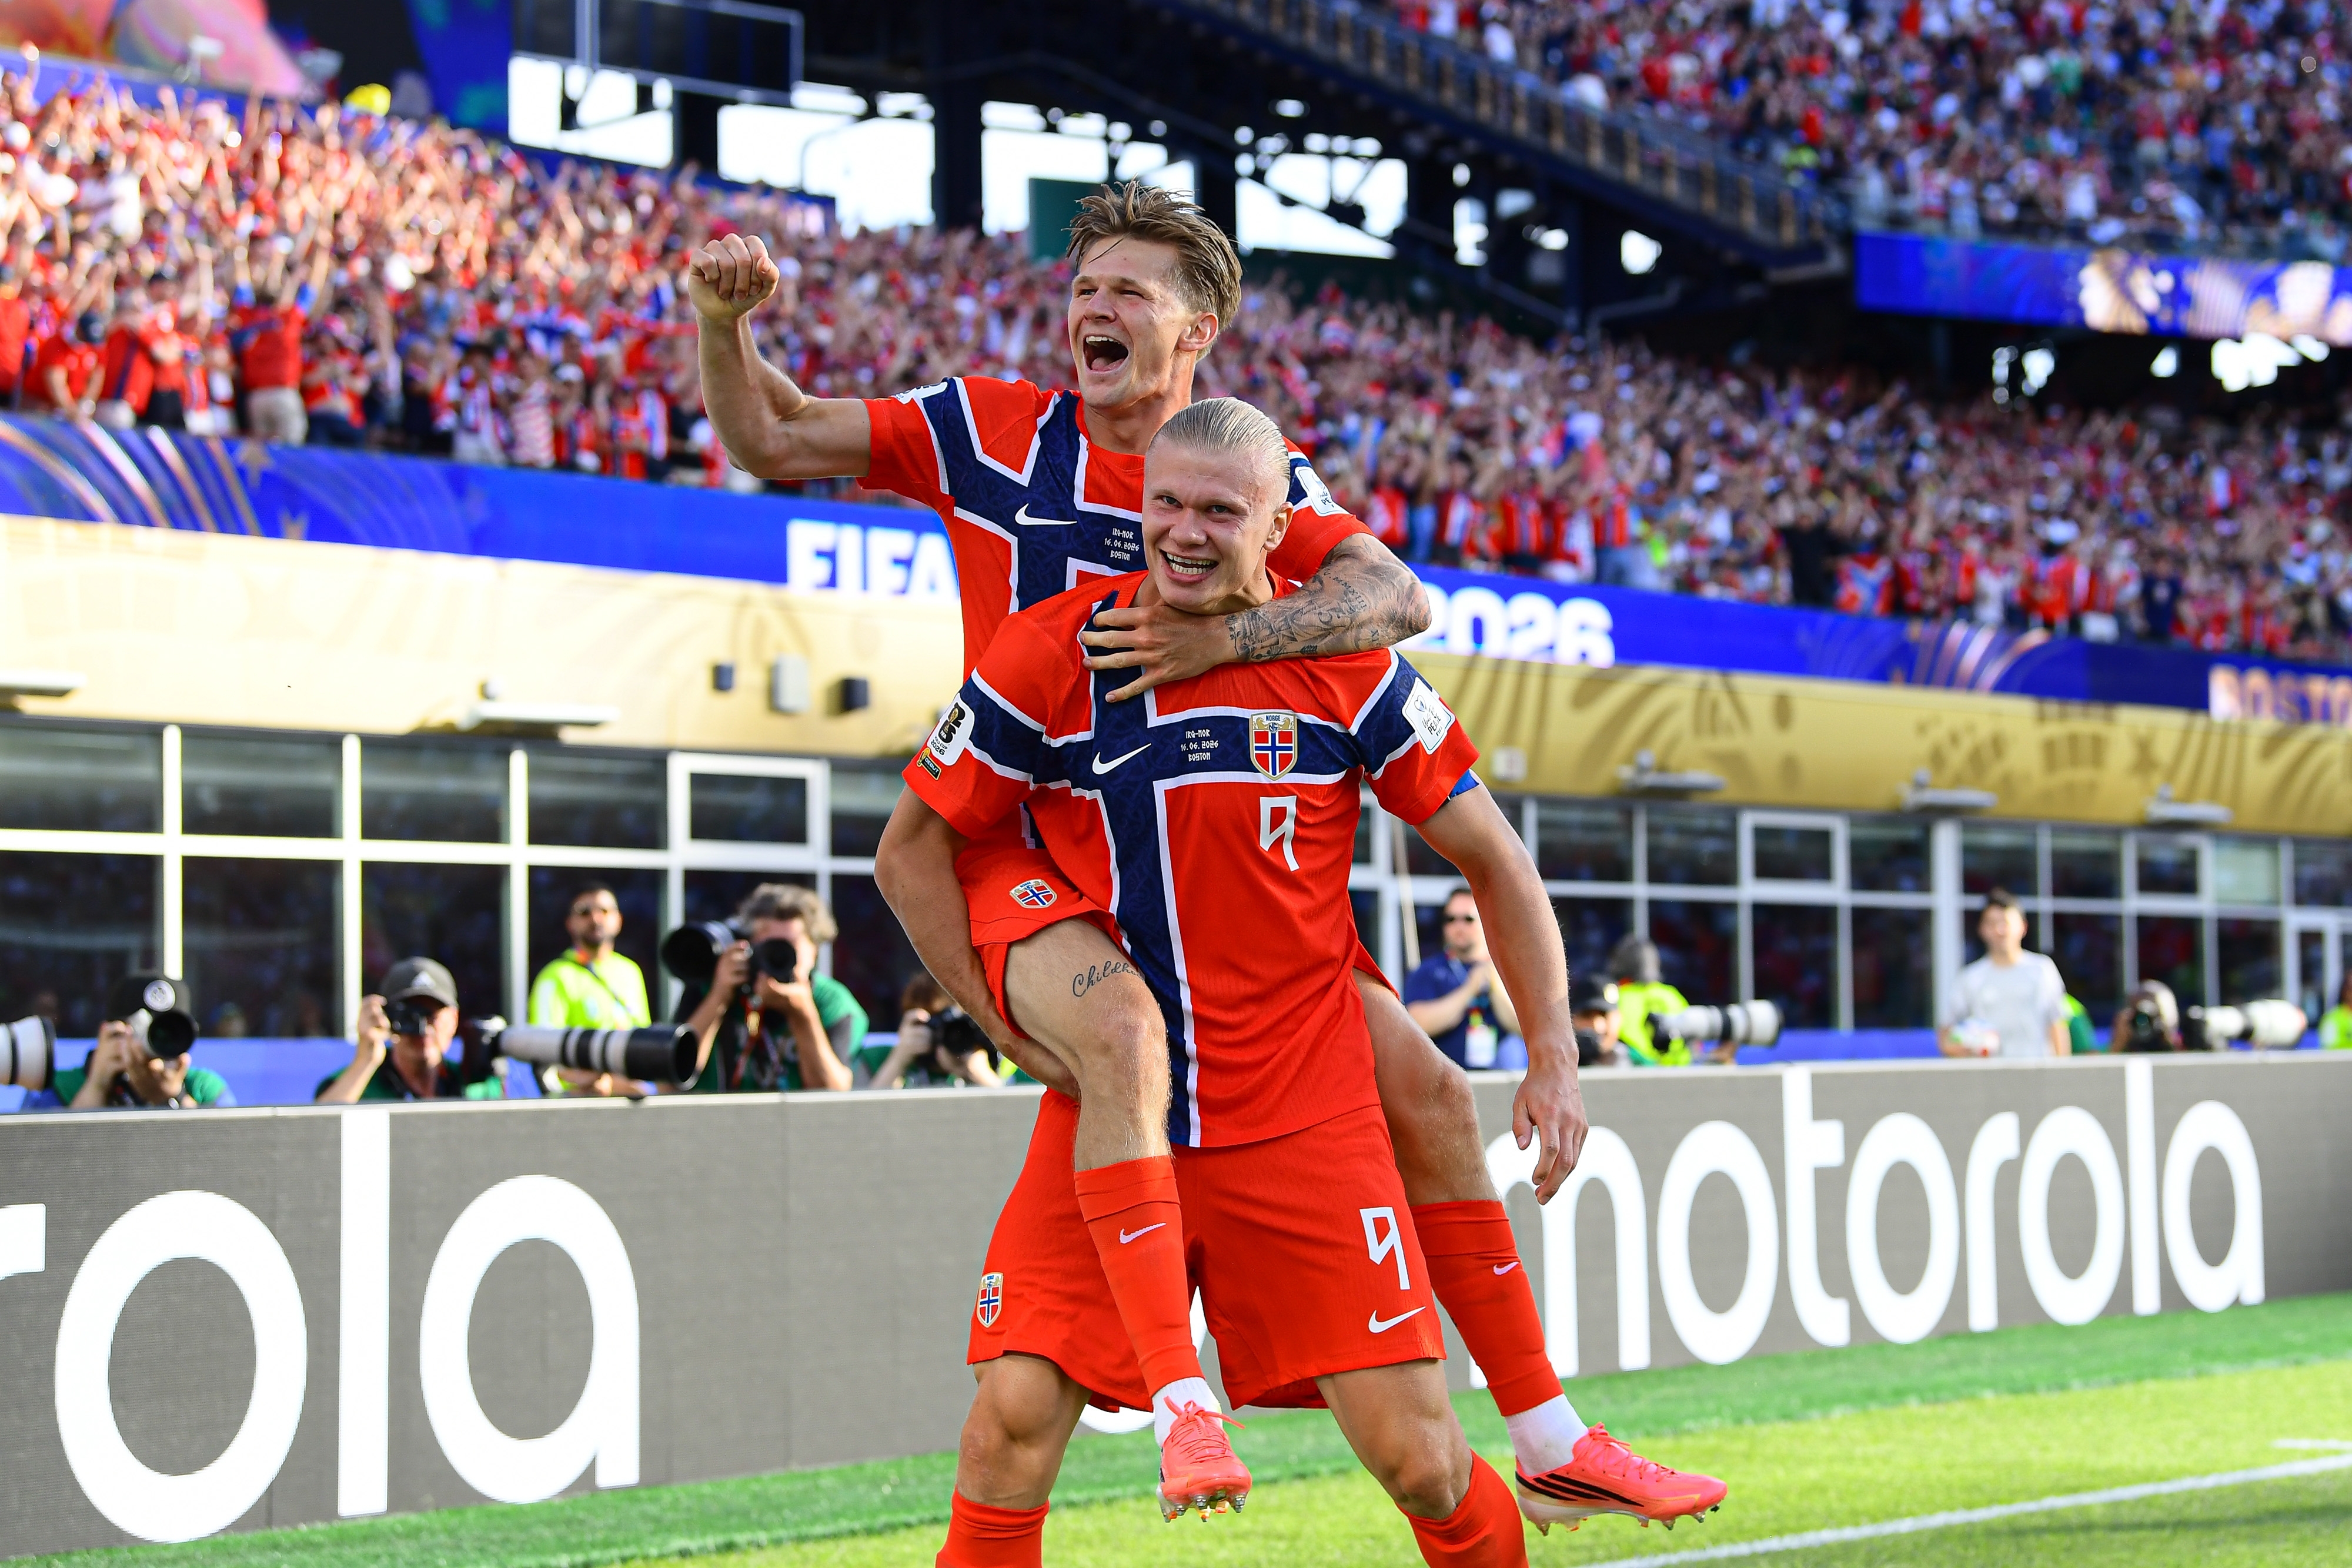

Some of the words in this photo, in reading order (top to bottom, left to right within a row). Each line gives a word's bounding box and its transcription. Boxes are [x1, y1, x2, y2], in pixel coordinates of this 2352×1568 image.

[1112, 527, 1134, 540] IRQ-NOR
[786, 517, 960, 599] FIFA
[1110, 550, 1130, 561] BOSTON
[1185, 729, 1210, 739] IRQ-NOR
[930, 739, 946, 755] 2026
[1180, 740, 1219, 752] 16.06.2026
[924, 757, 939, 773] DEBUT
[1188, 752, 1211, 762] BOSTON
[1259, 795, 1299, 872] 9
[1469, 1059, 2264, 1389] motorola
[1359, 1206, 1411, 1290] 9
[0, 1109, 640, 1543] ola
